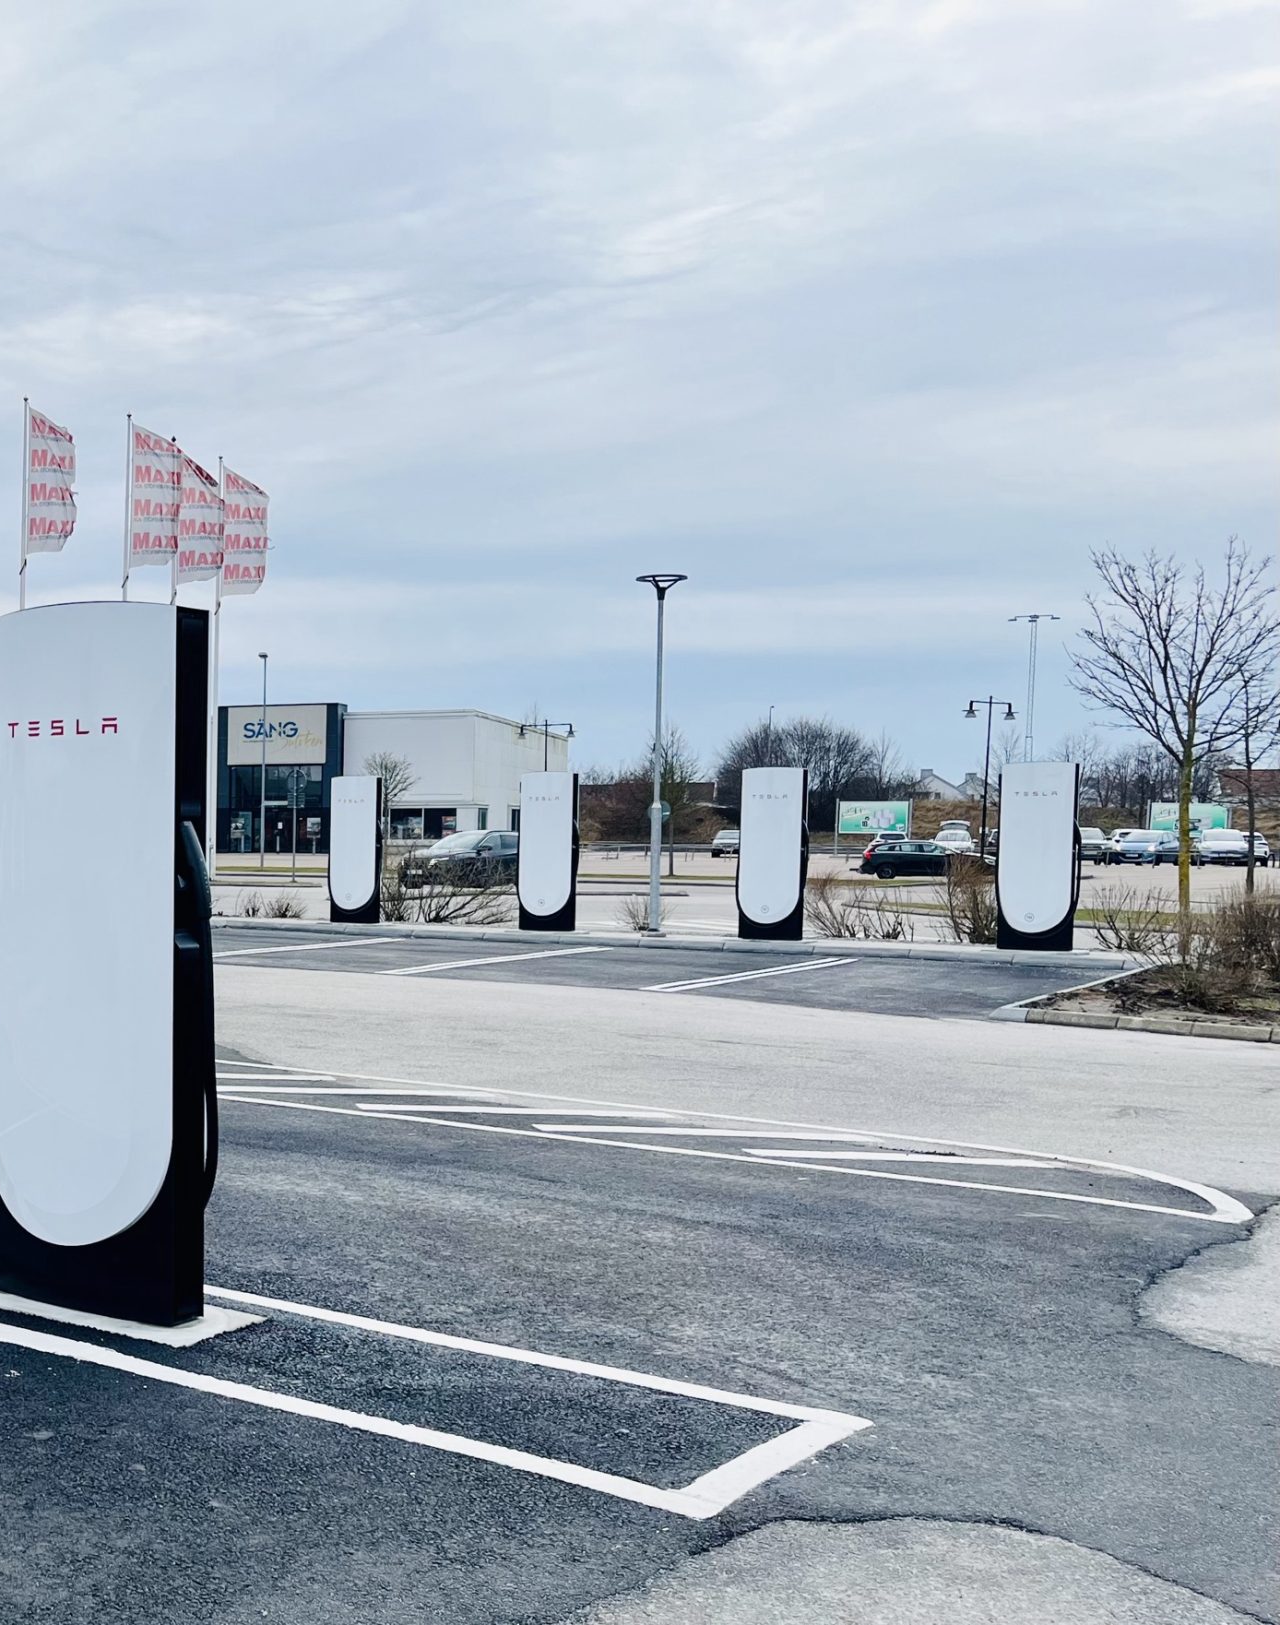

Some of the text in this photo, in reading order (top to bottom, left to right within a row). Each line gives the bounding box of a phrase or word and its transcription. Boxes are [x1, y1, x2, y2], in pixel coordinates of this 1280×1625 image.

[31, 449, 74, 469] MAXI
[30, 483, 73, 502] MAX
[225, 504, 267, 520] MAXI
[180, 519, 224, 536] MAXI
[225, 534, 268, 550] MAXI
[179, 551, 224, 567] MAXI
[8, 717, 117, 738] TESLA
[243, 718, 298, 738] SÄNG
